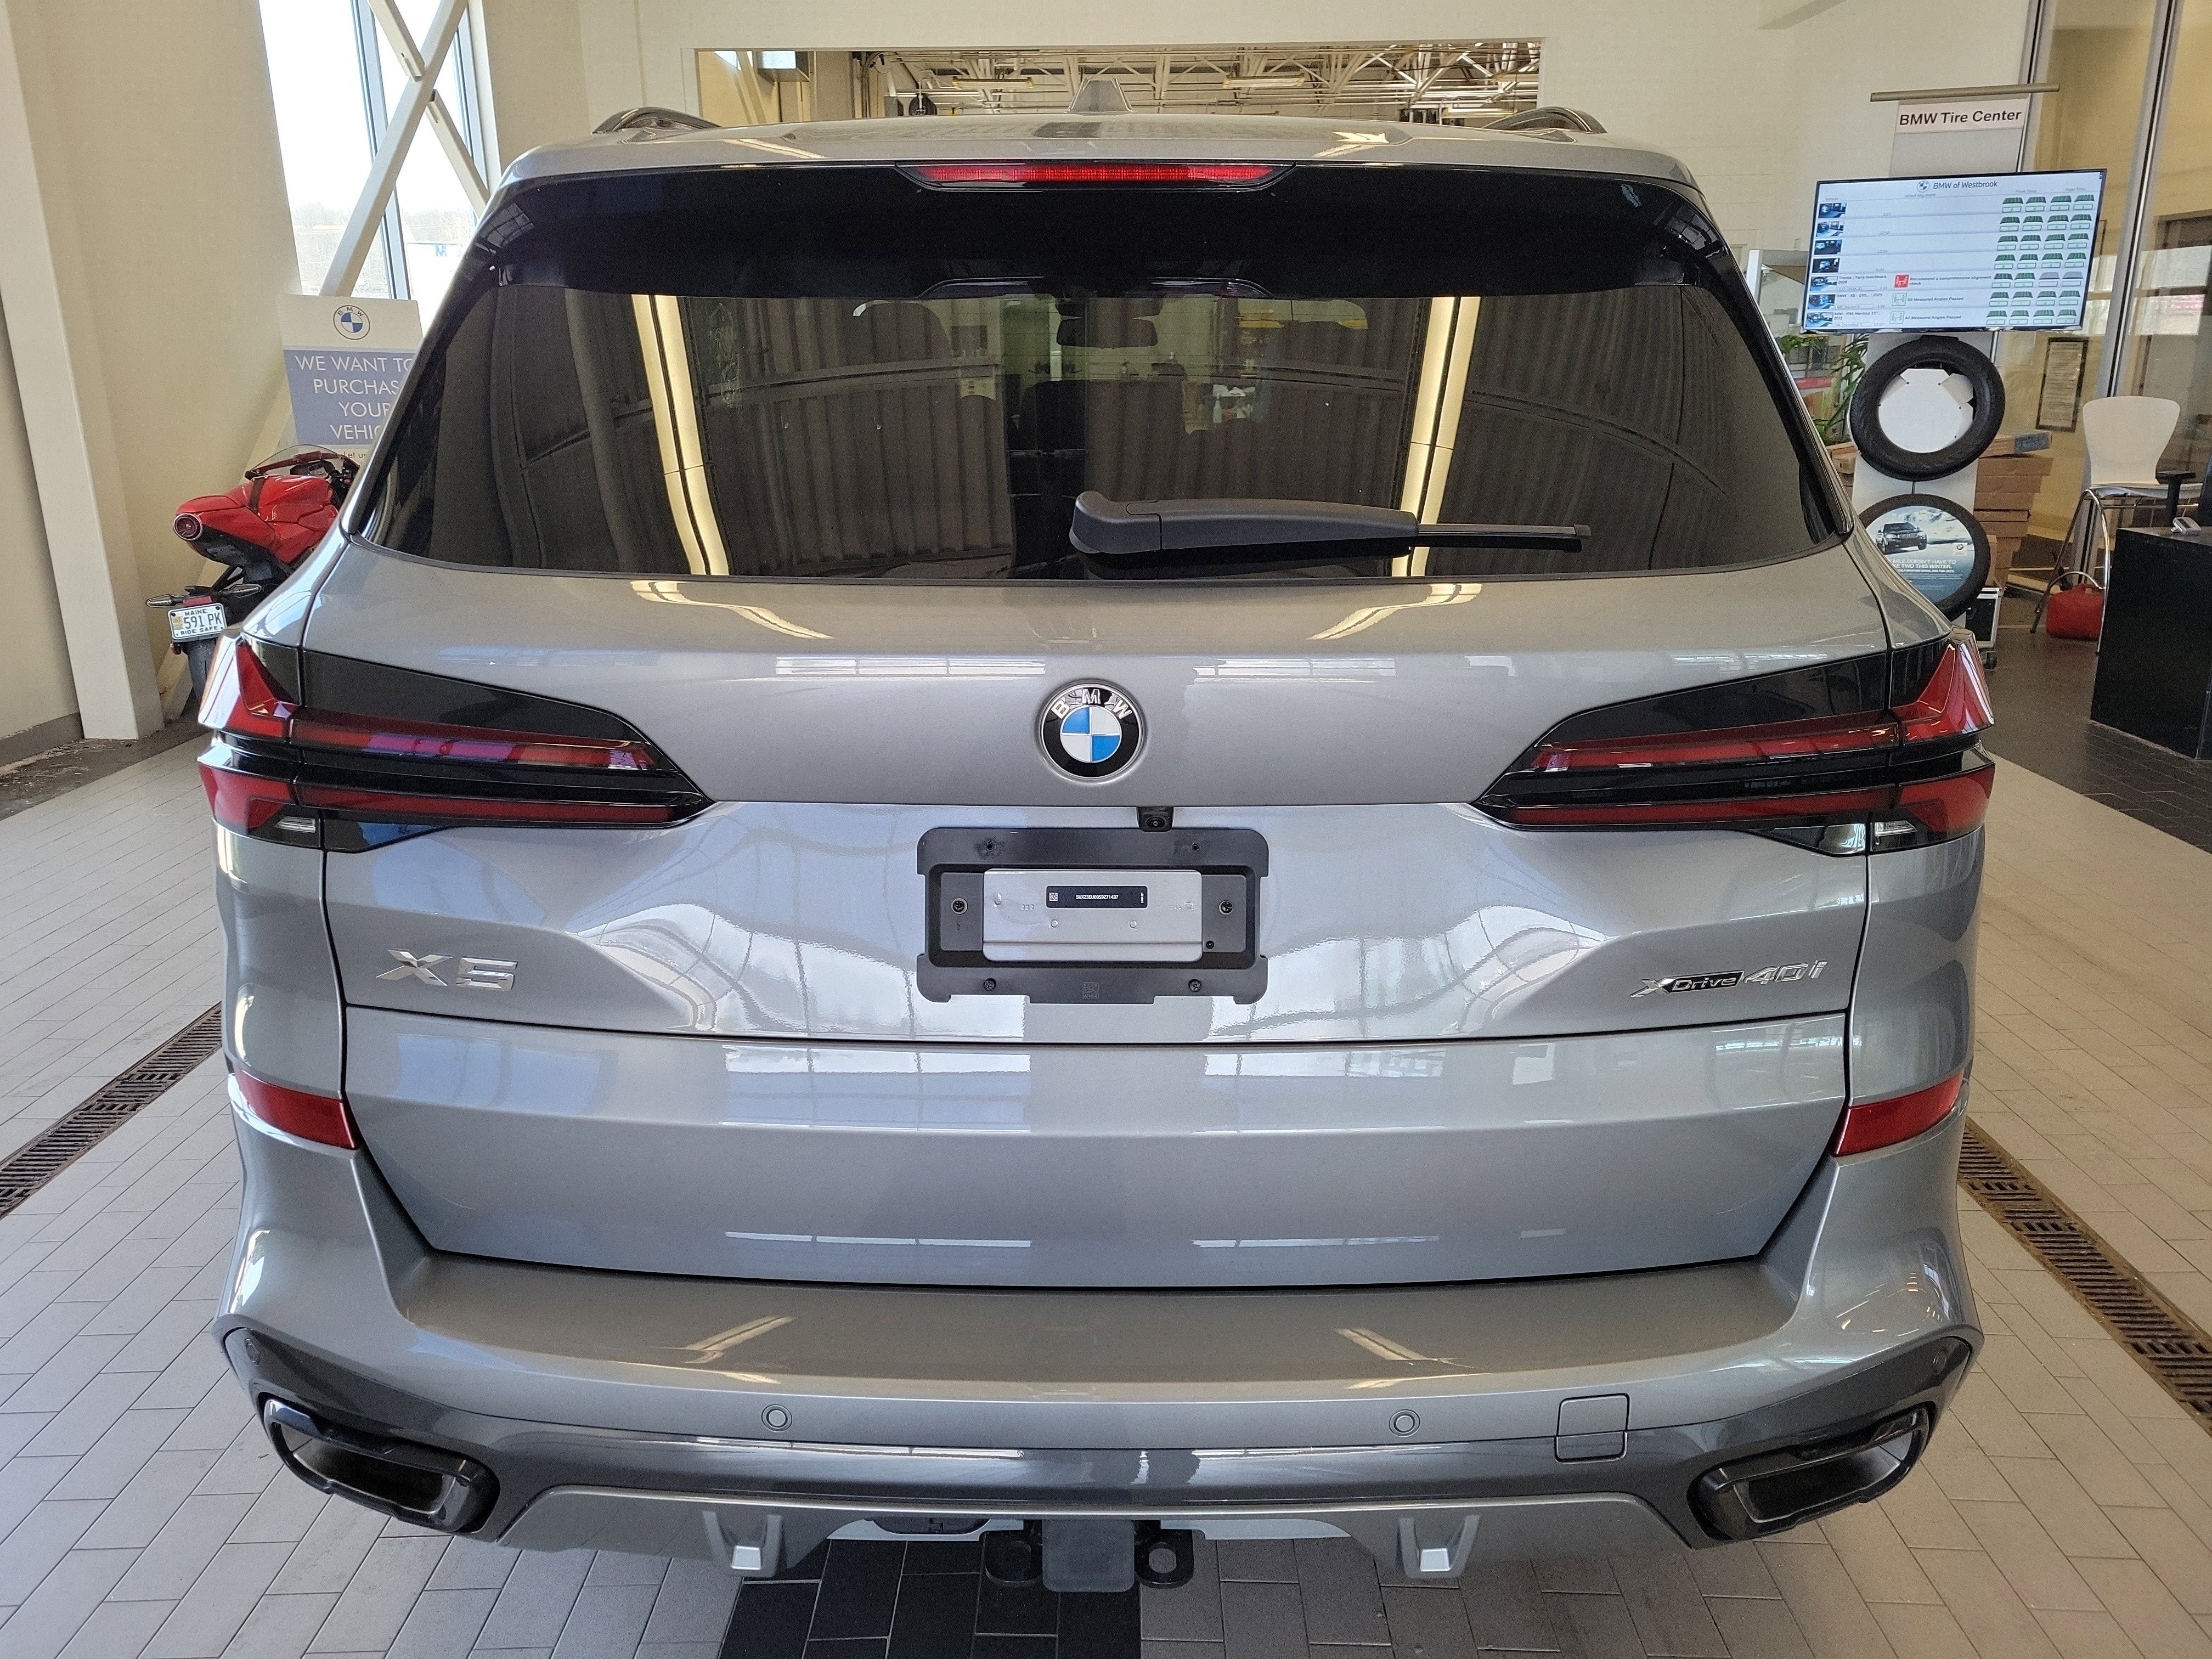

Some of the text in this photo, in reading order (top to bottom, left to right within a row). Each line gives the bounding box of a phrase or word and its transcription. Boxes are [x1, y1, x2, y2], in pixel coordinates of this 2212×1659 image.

[1899, 110, 2022, 126] BMW Tire Center
[337, 307, 364, 316] BMW
[295, 356, 326, 371] WE
[330, 356, 387, 372] WANT
[313, 379, 399, 395] PURCHAS
[330, 425, 381, 439] VEHI
[183, 615, 205, 629] 591
[207, 612, 222, 625] PK
[1051, 689, 1132, 719] BMW
[375, 949, 519, 991] X5
